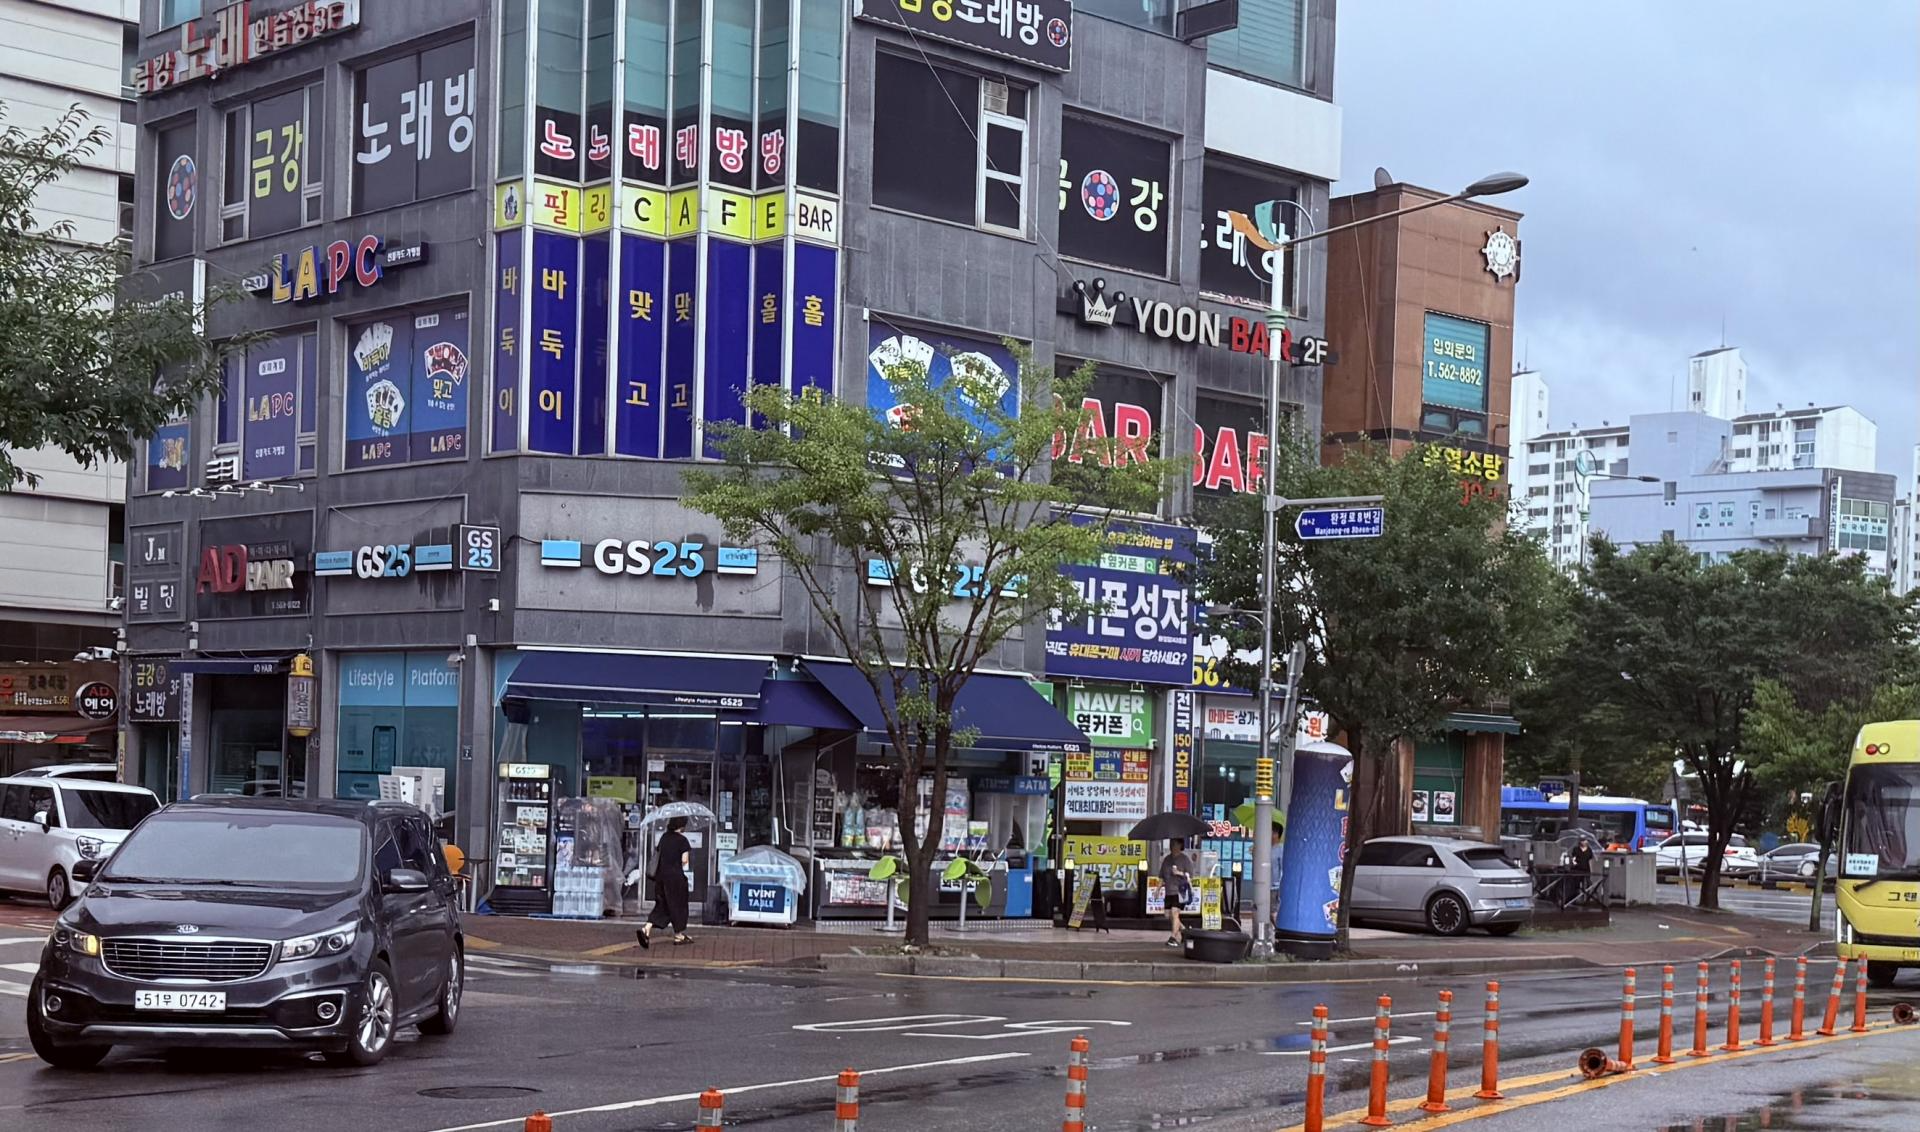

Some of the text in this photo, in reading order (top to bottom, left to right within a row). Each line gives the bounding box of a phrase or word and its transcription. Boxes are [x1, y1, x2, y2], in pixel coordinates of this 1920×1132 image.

[131, 50, 177, 94] 금강
[252, 120, 303, 198] 금강
[798, 203, 833, 233] BAR
[538, 267, 568, 421] 바둑이
[1132, 297, 1329, 365] YOON BAR 2F
[625, 288, 654, 408] 맞고
[671, 291, 692, 408] 맞고
[467, 530, 493, 548] GS
[196, 544, 295, 594] AD HAIR
[356, 544, 411, 579] GS25
[468, 549, 493, 568] 25
[593, 538, 705, 578] GS25
[136, 663, 155, 687] 금강
[348, 667, 395, 692] Lifestyle
[135, 691, 167, 718] 노래방
[720, 697, 743, 708] GS25
[1074, 691, 1145, 715] NAVER
[748, 889, 776, 898] EVENT
[749, 898, 774, 909] TABLE
[179, 994, 217, 1008] 0742
